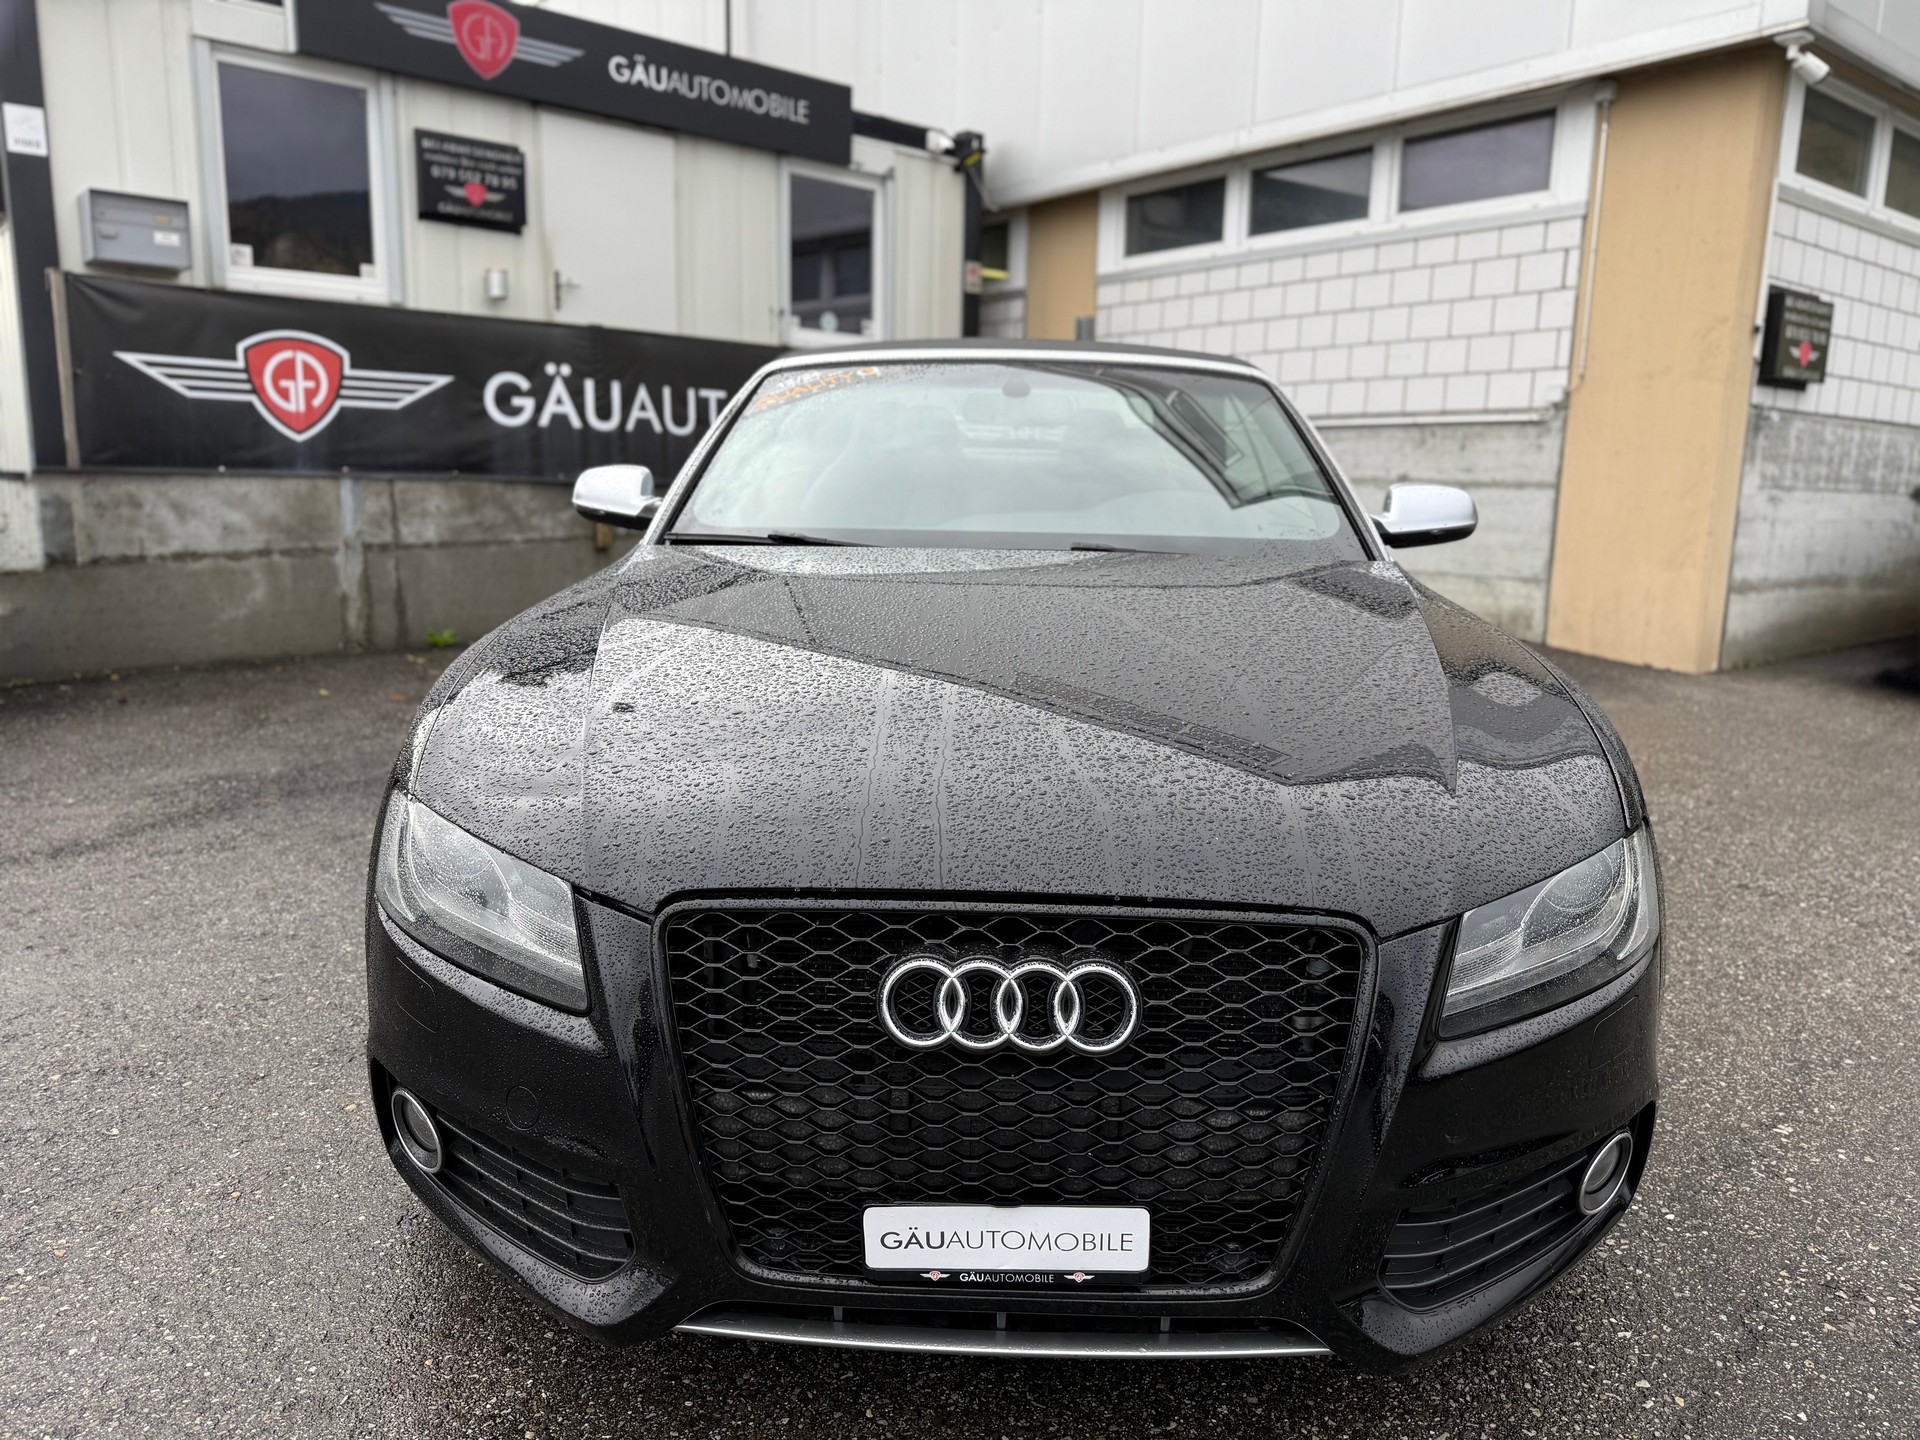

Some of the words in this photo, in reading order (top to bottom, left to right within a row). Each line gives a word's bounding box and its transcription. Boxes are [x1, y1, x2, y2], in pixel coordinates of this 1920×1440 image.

[607, 53, 811, 125] GÄUAUTOMOBILE
[879, 1226, 1134, 1252] GÄUAUTOMOBILE
[959, 1271, 1055, 1283] GÄUAUTOMOBILE
